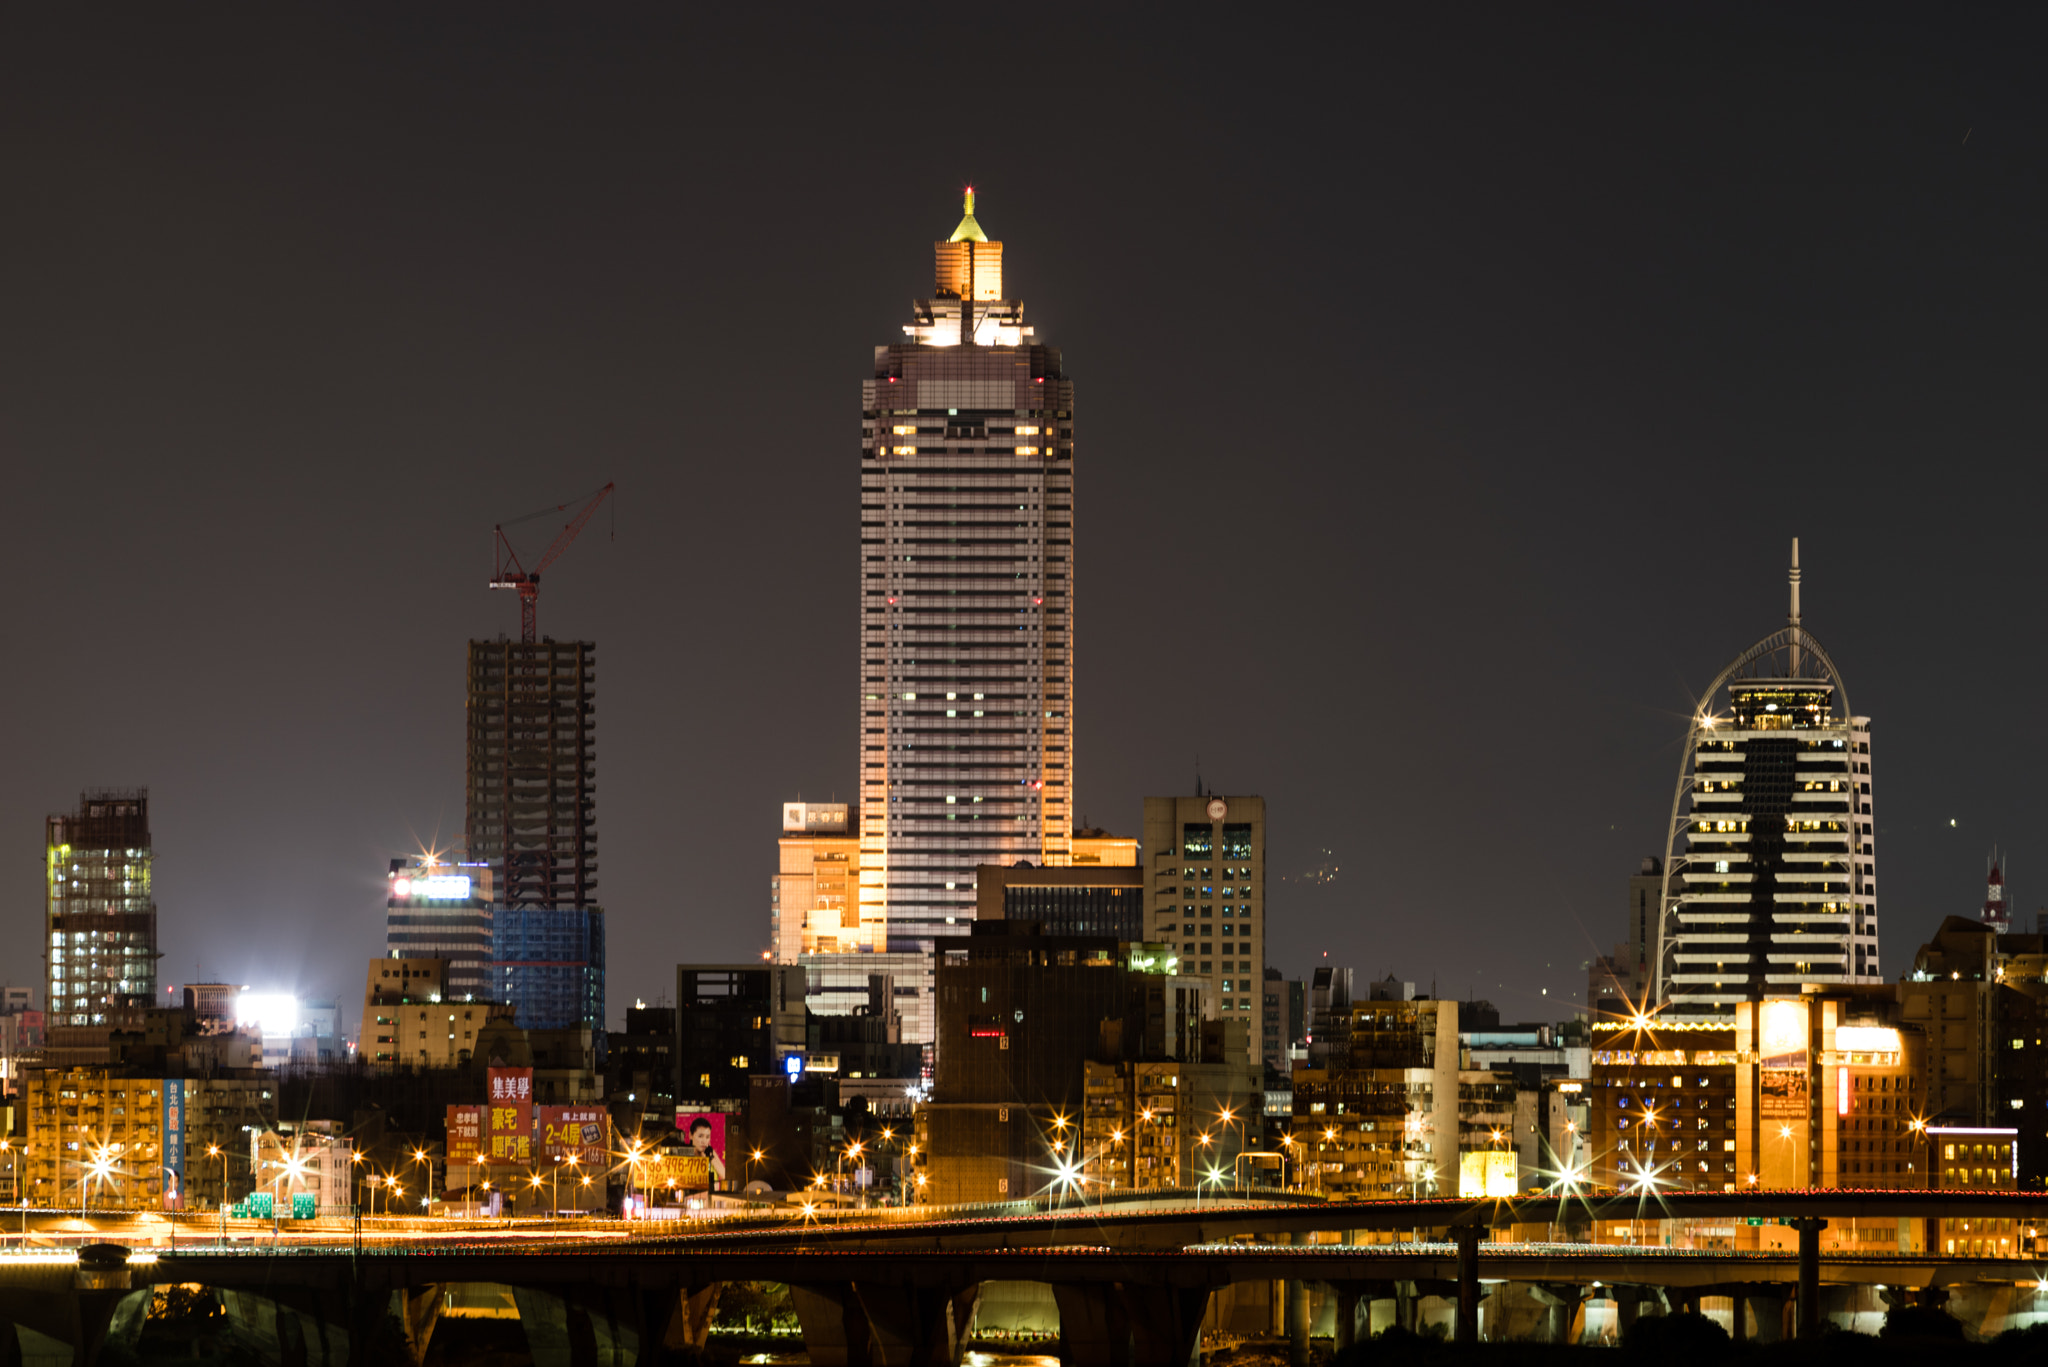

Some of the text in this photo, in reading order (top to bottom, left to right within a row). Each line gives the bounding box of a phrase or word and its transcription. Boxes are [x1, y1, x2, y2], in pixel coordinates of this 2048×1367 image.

[1000, 1037, 1008, 1049] 12
[492, 1077, 530, 1100] 集美學
[491, 1107, 518, 1130] 豪宅
[1001, 1109, 1007, 1121] 9
[449, 1126, 479, 1139] 一下就到
[545, 1123, 580, 1146] 2-4房
[492, 1135, 530, 1160] 輕門檻
[1000, 1179, 1007, 1192] 6
